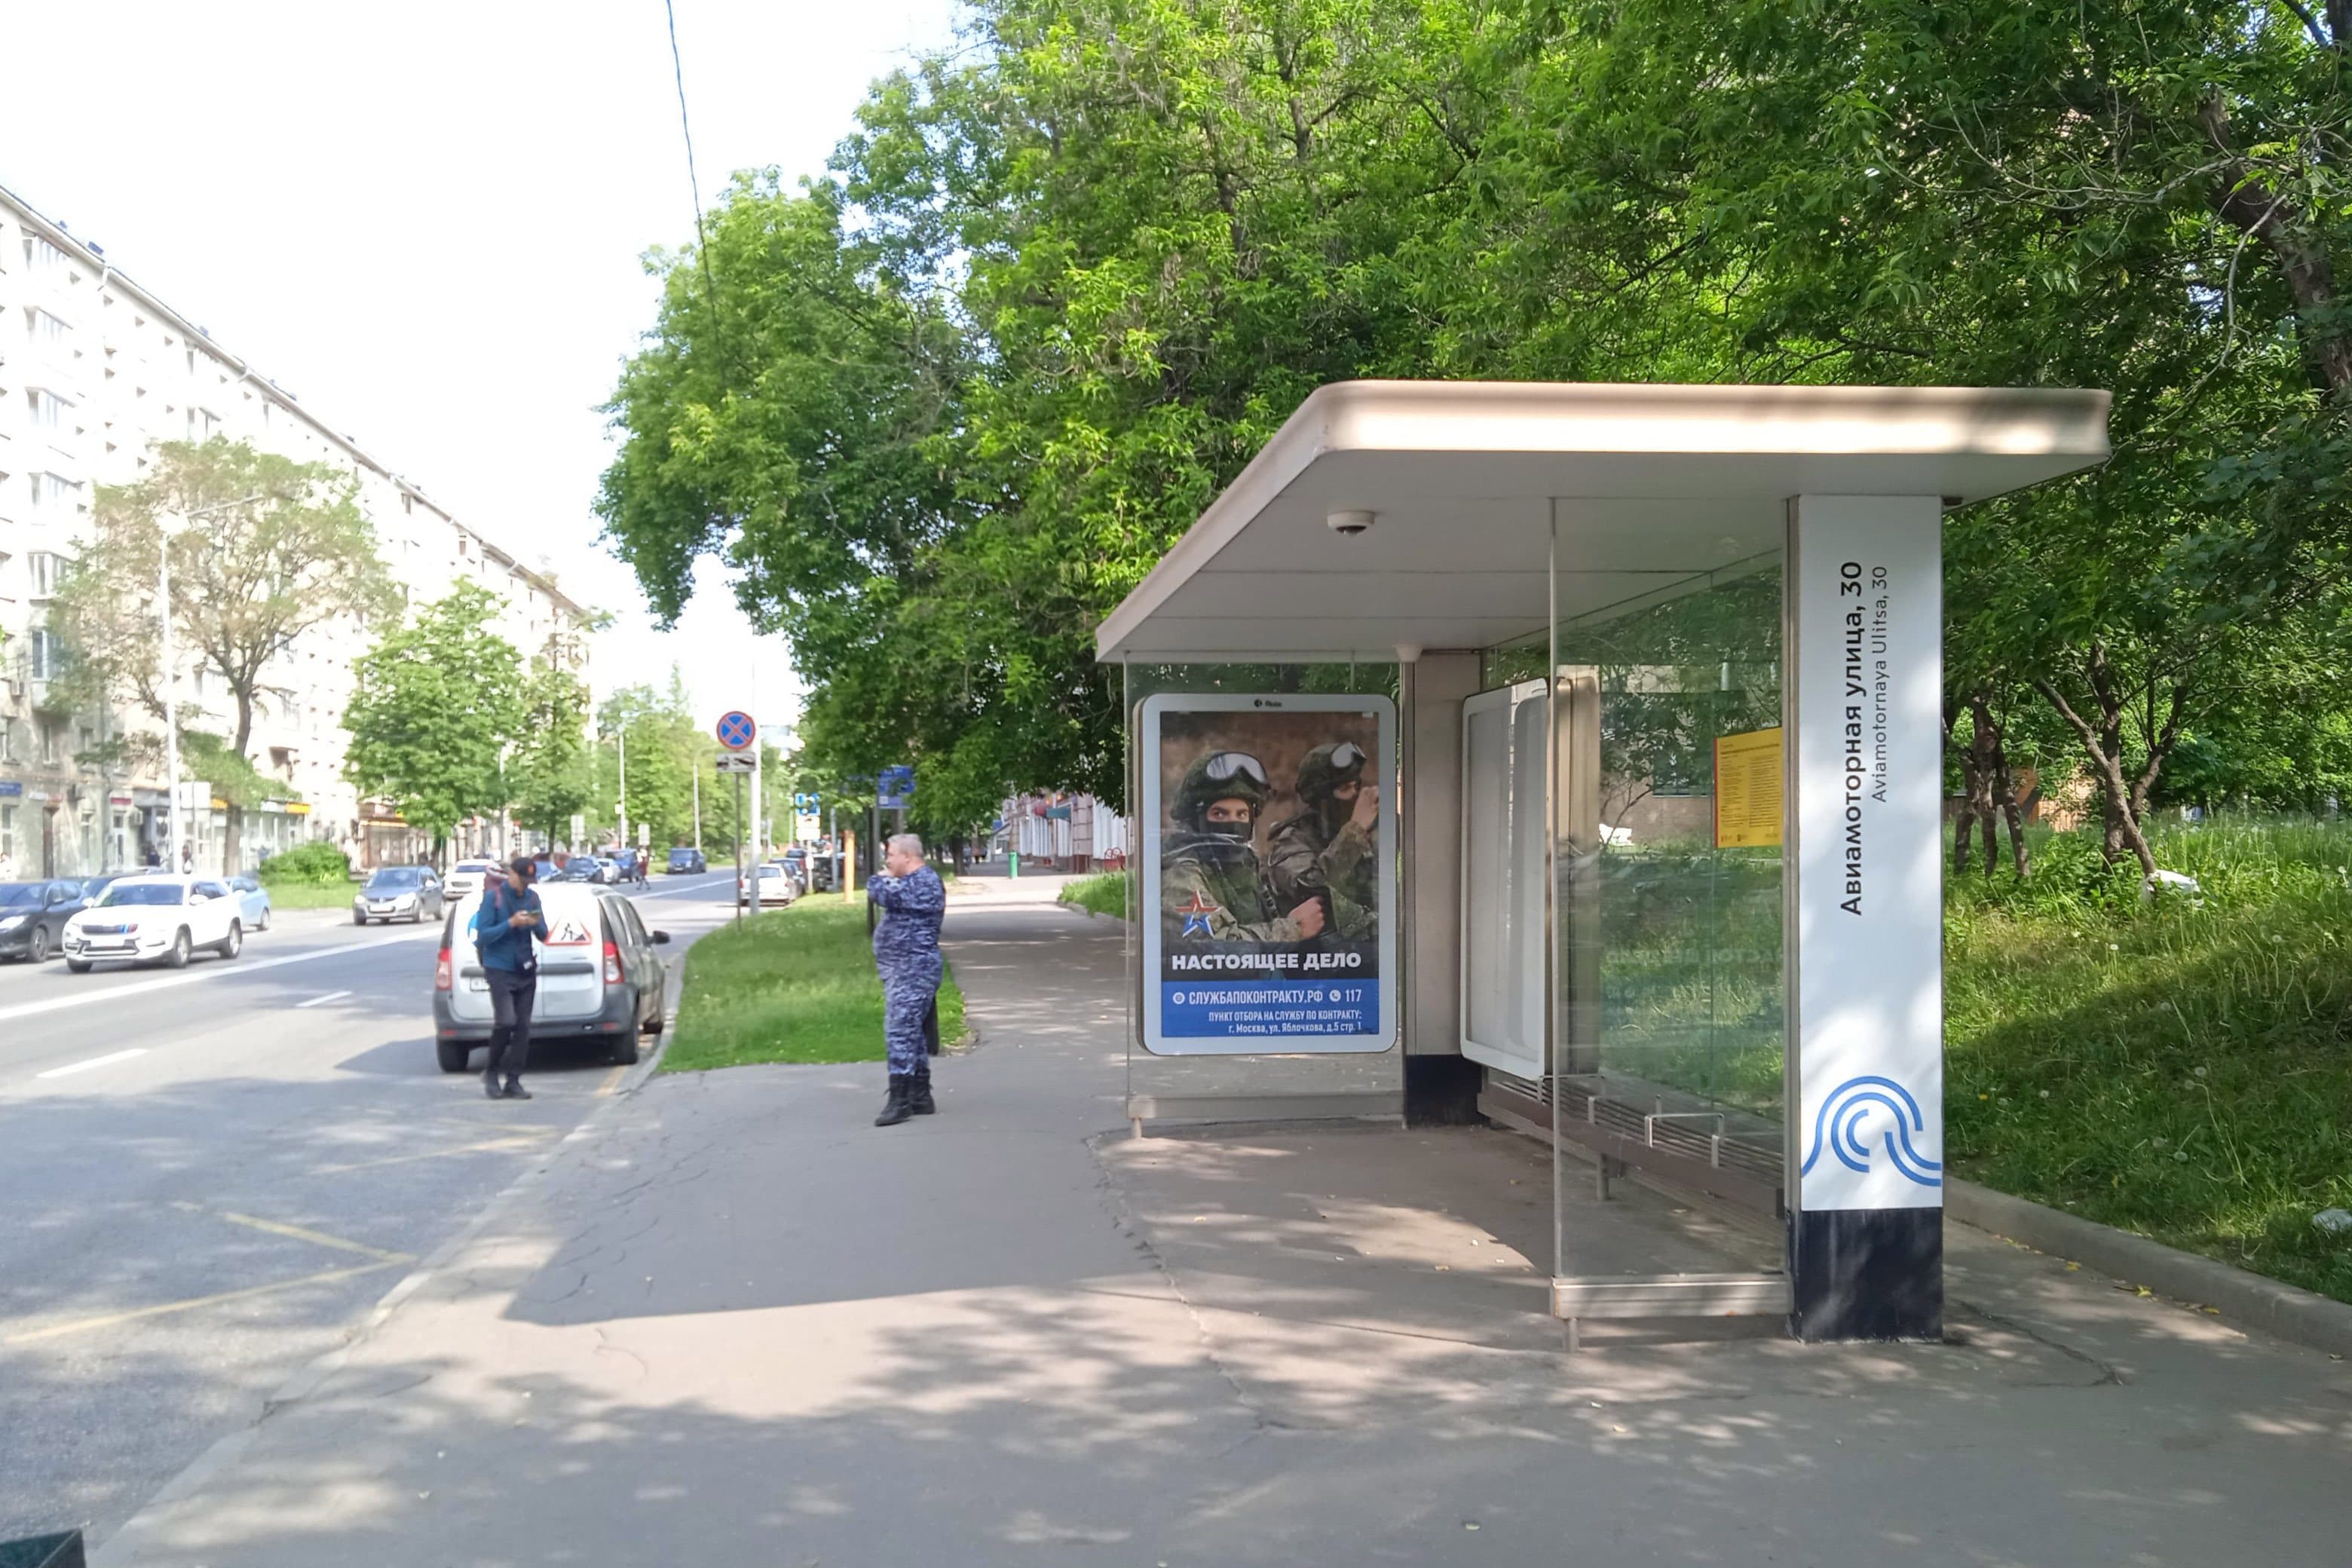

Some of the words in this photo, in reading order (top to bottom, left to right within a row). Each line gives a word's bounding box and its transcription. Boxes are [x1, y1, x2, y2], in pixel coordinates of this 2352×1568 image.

[1840, 562, 1862, 597] 30
[1872, 566, 1887, 590] 30
[1871, 595, 1889, 654] Ulitsa,
[1846, 605, 1867, 697] улица,
[1872, 660, 1890, 803] Aviamotornaya
[1840, 706, 1866, 915] Авиамоторная
[1171, 954, 1299, 971] НАСТОЯЩЕЕ
[1303, 952, 1361, 970] ДЕЛО
[1189, 989, 1323, 1005] СЛУЖБАПОКОНТРАКТУ.РФ
[1345, 989, 1361, 1002] 117
[1208, 1012, 1233, 1021] ПУНКТ
[1234, 1011, 1263, 1021] ОТБОРА
[1263, 1011, 1274, 1021] НА
[1275, 1010, 1305, 1021] СЛУЖБУ
[1306, 1010, 1316, 1020] ПО
[1318, 1009, 1362, 1020] КОНТРАКТУ:
[1229, 1024, 1234, 1033] г.
[1236, 1024, 1268, 1034] Москва,
[1269, 1024, 1281, 1034] ул.
[1282, 1022, 1325, 1033] Яблочкова,
[1340, 1022, 1356, 1034] стр.
